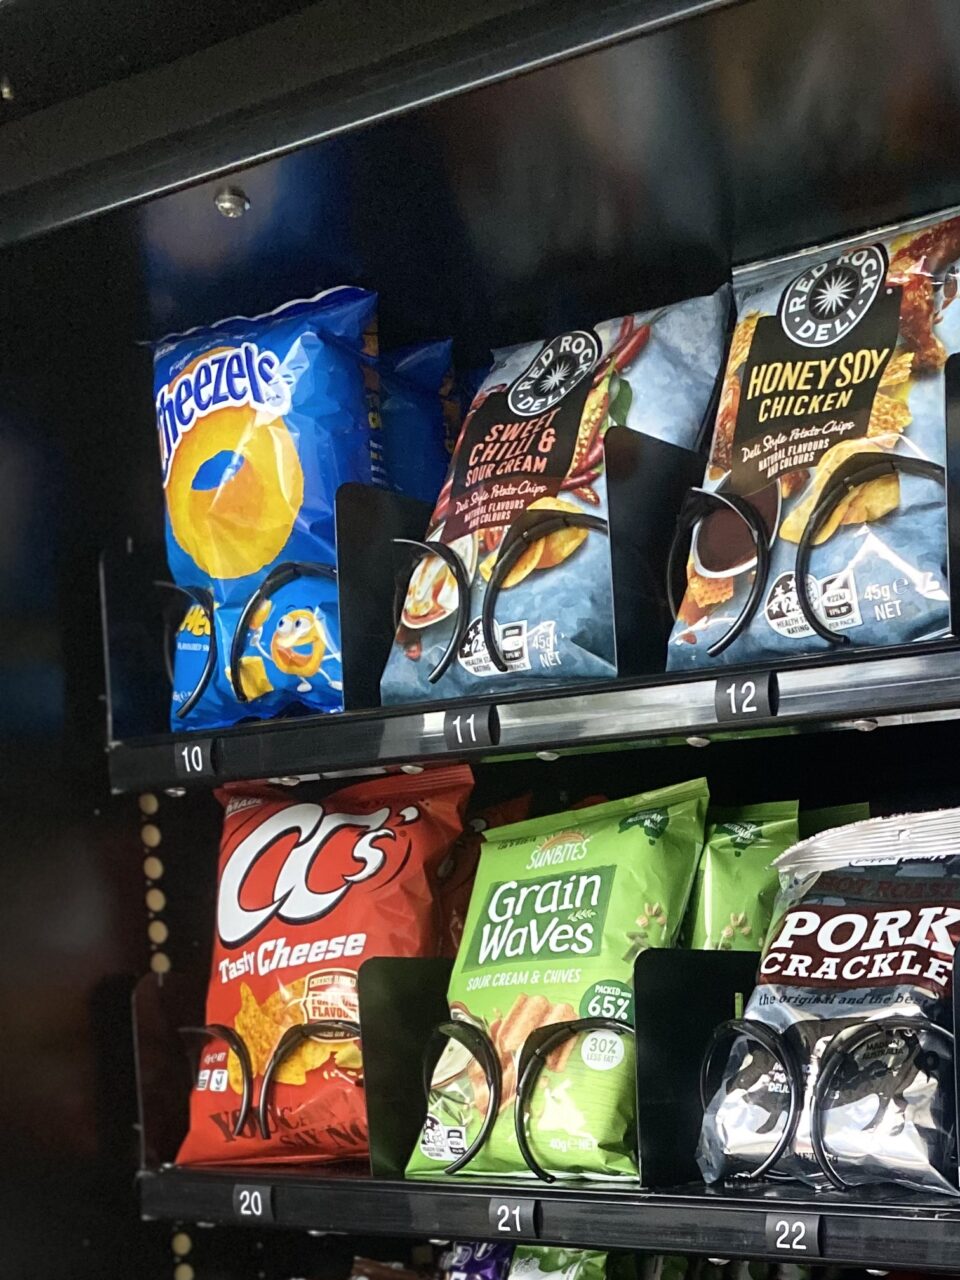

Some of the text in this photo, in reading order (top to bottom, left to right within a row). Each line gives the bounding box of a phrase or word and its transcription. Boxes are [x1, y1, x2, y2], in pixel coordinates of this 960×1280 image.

[789, 249, 878, 313] RED ROCK
[796, 309, 857, 342] DELI
[517, 335, 592, 391] RED ROCK
[746, 348, 890, 400] HONEY SOY
[156, 343, 284, 456] heezels
[516, 387, 568, 412] DELI
[758, 388, 854, 423] CHICKEN
[484, 407, 562, 442] SWEET
[468, 428, 556, 466] CHILLI &
[741, 420, 855, 463] Deli Style Potato Chips
[758, 438, 830, 472] NATURAL FLAVOURS
[465, 455, 548, 488] SOUR CREAM
[779, 451, 815, 471] COLOURS
[487, 499, 525, 513] FLAVOURS
[864, 584, 891, 602] 45g
[874, 600, 902, 621] NET
[540, 651, 562, 668] NET
[726, 681, 757, 714] 12
[452, 714, 477, 743] 11
[181, 745, 204, 772] 10
[526, 836, 592, 870] SUNBITES
[488, 874, 601, 923] Grain
[478, 917, 593, 965] Waves
[218, 933, 367, 983] Tasty Cheese
[760, 950, 953, 987] CRACKLE
[466, 968, 582, 991] SOUR CREAM & CHIVES
[595, 985, 621, 996] PACKED
[587, 996, 630, 1020] 65%
[758, 992, 890, 1007] the original and the
[589, 1037, 616, 1053] 30%
[240, 1191, 262, 1216] 20
[497, 1205, 521, 1232] 21
[775, 1220, 807, 1250] 22
